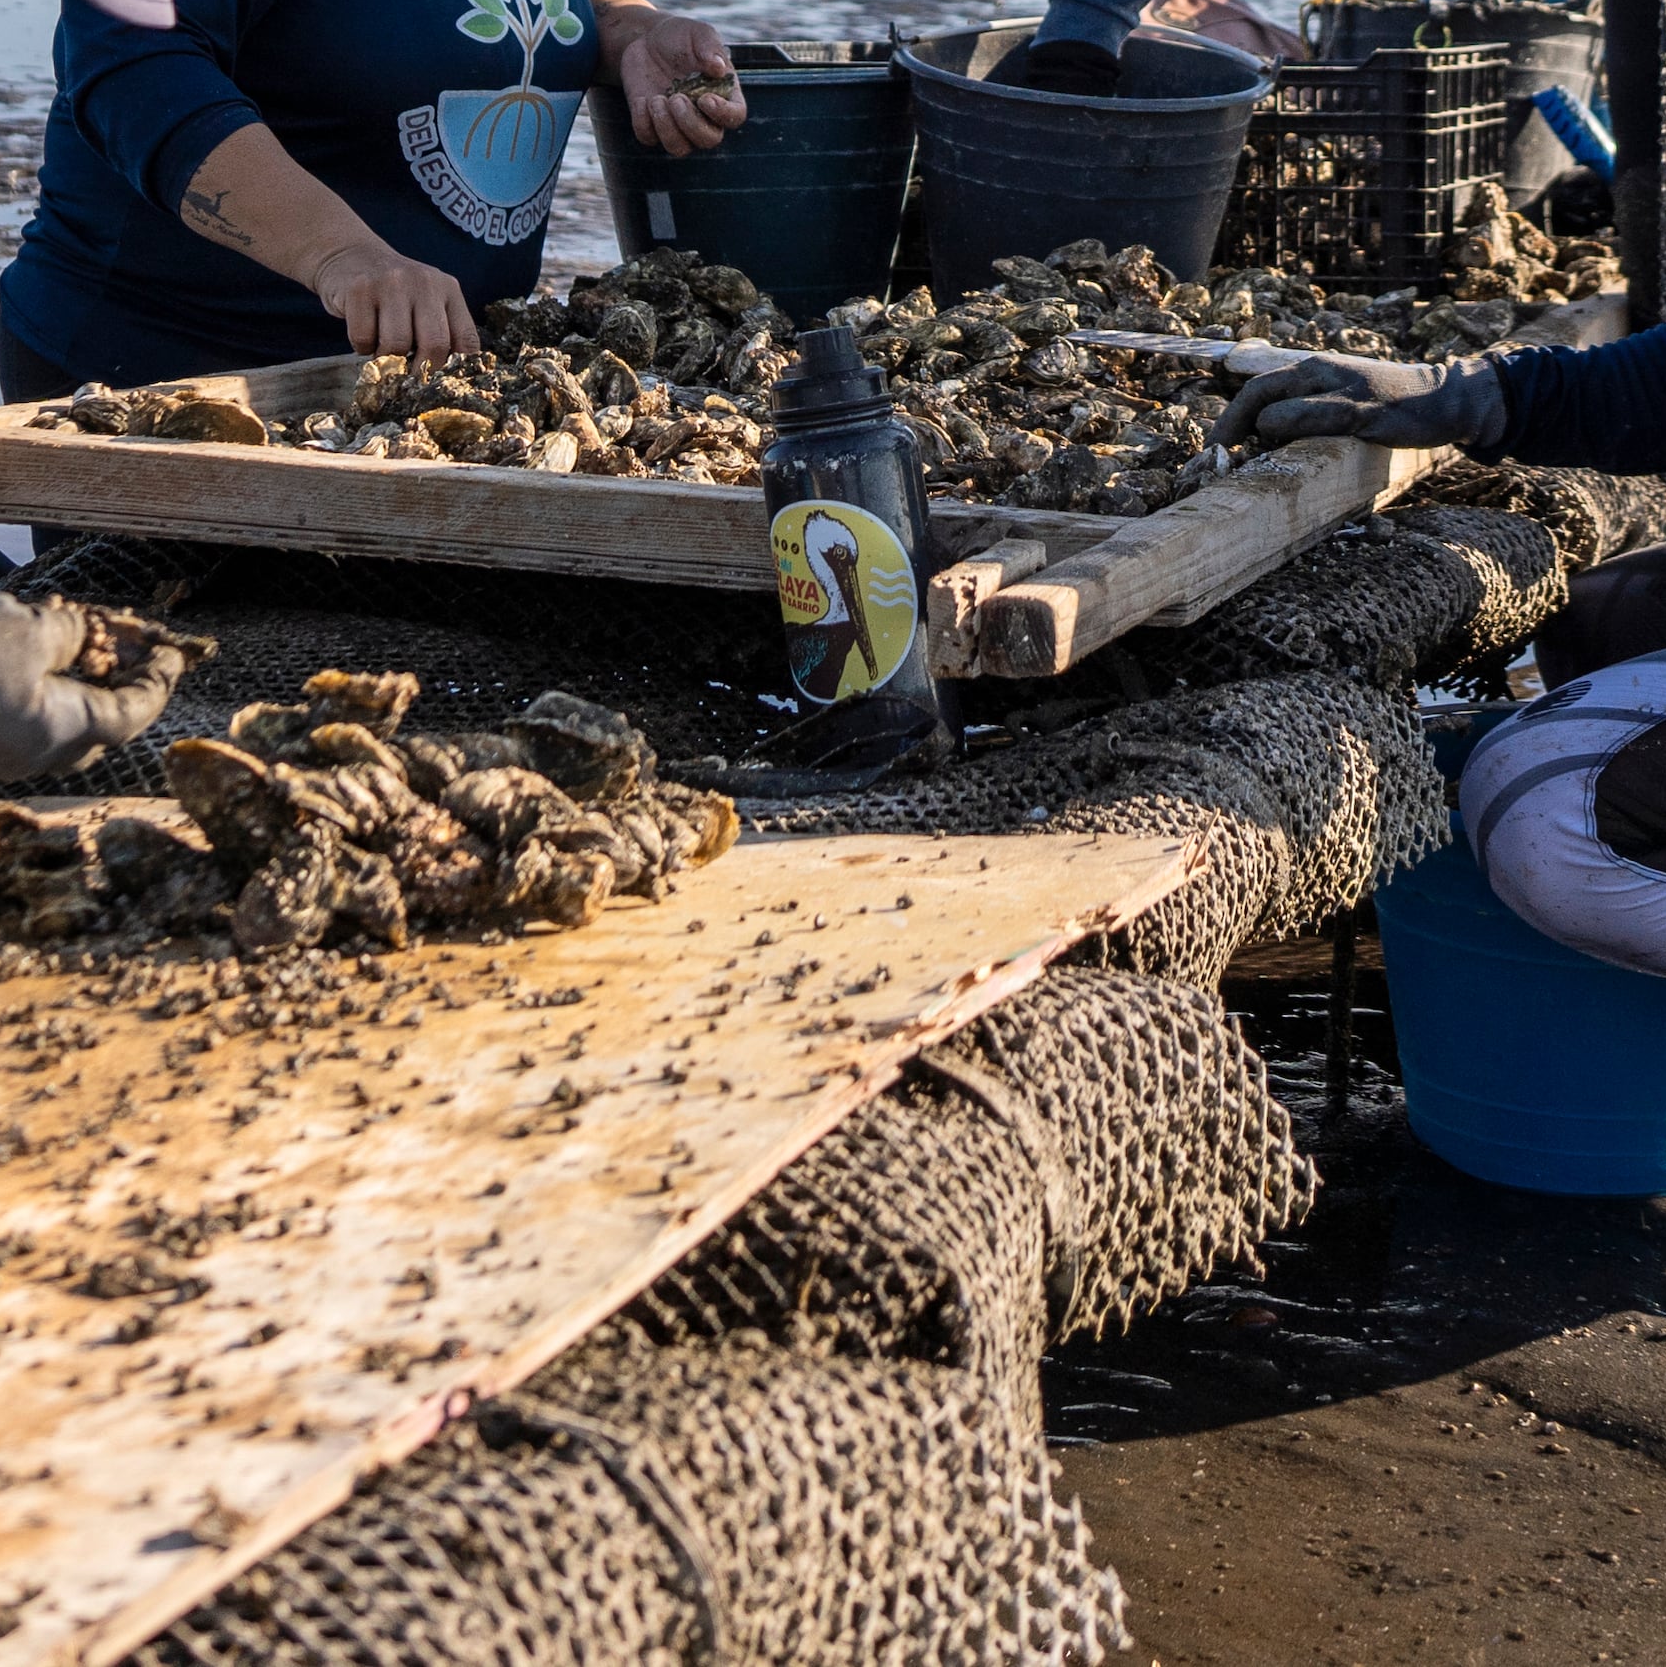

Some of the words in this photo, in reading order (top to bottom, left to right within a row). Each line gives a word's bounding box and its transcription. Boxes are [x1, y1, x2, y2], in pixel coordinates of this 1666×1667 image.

[402, 107, 435, 160] DEL
[414, 154, 489, 235] ESTERO
[486, 210, 506, 242] EL
[778, 571, 820, 603] LAYA
